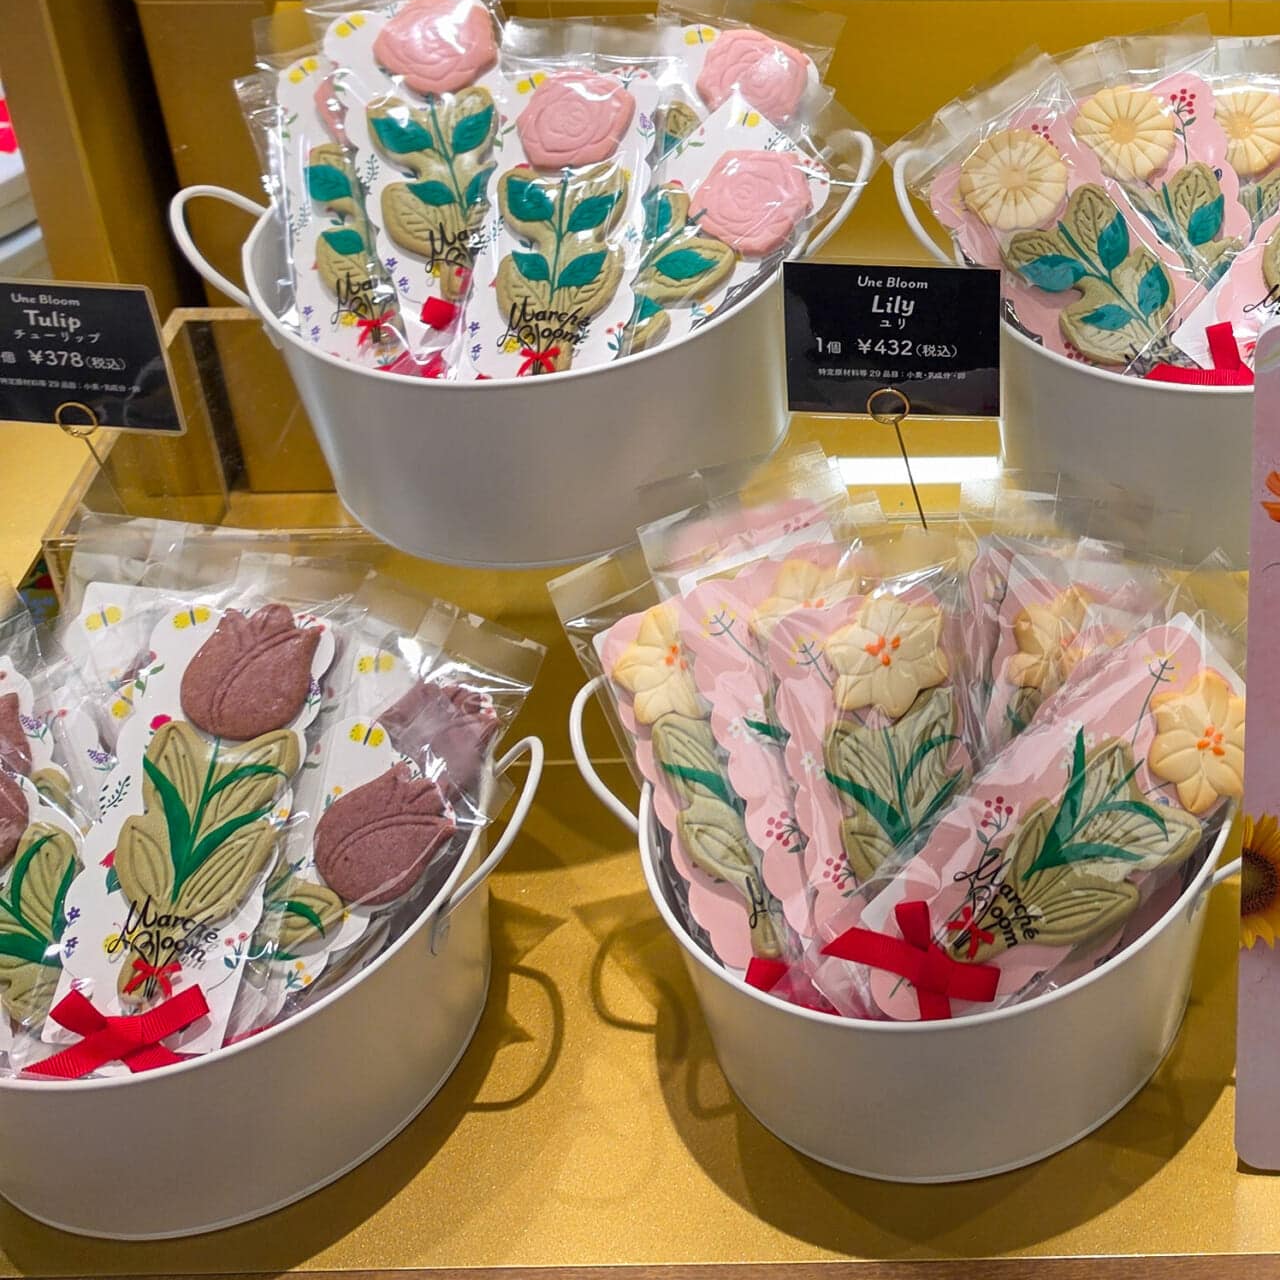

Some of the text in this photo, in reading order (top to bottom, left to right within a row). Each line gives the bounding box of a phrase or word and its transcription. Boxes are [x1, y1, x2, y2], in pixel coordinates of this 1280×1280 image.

[857, 275, 929, 290] Une Bloom
[10, 292, 81, 308] Une Bloom
[871, 294, 916, 317] Lily
[23, 309, 82, 333] Tulip
[879, 318, 907, 330] ユリ
[14, 328, 101, 344] チューリップ
[815, 336, 842, 355] 1個
